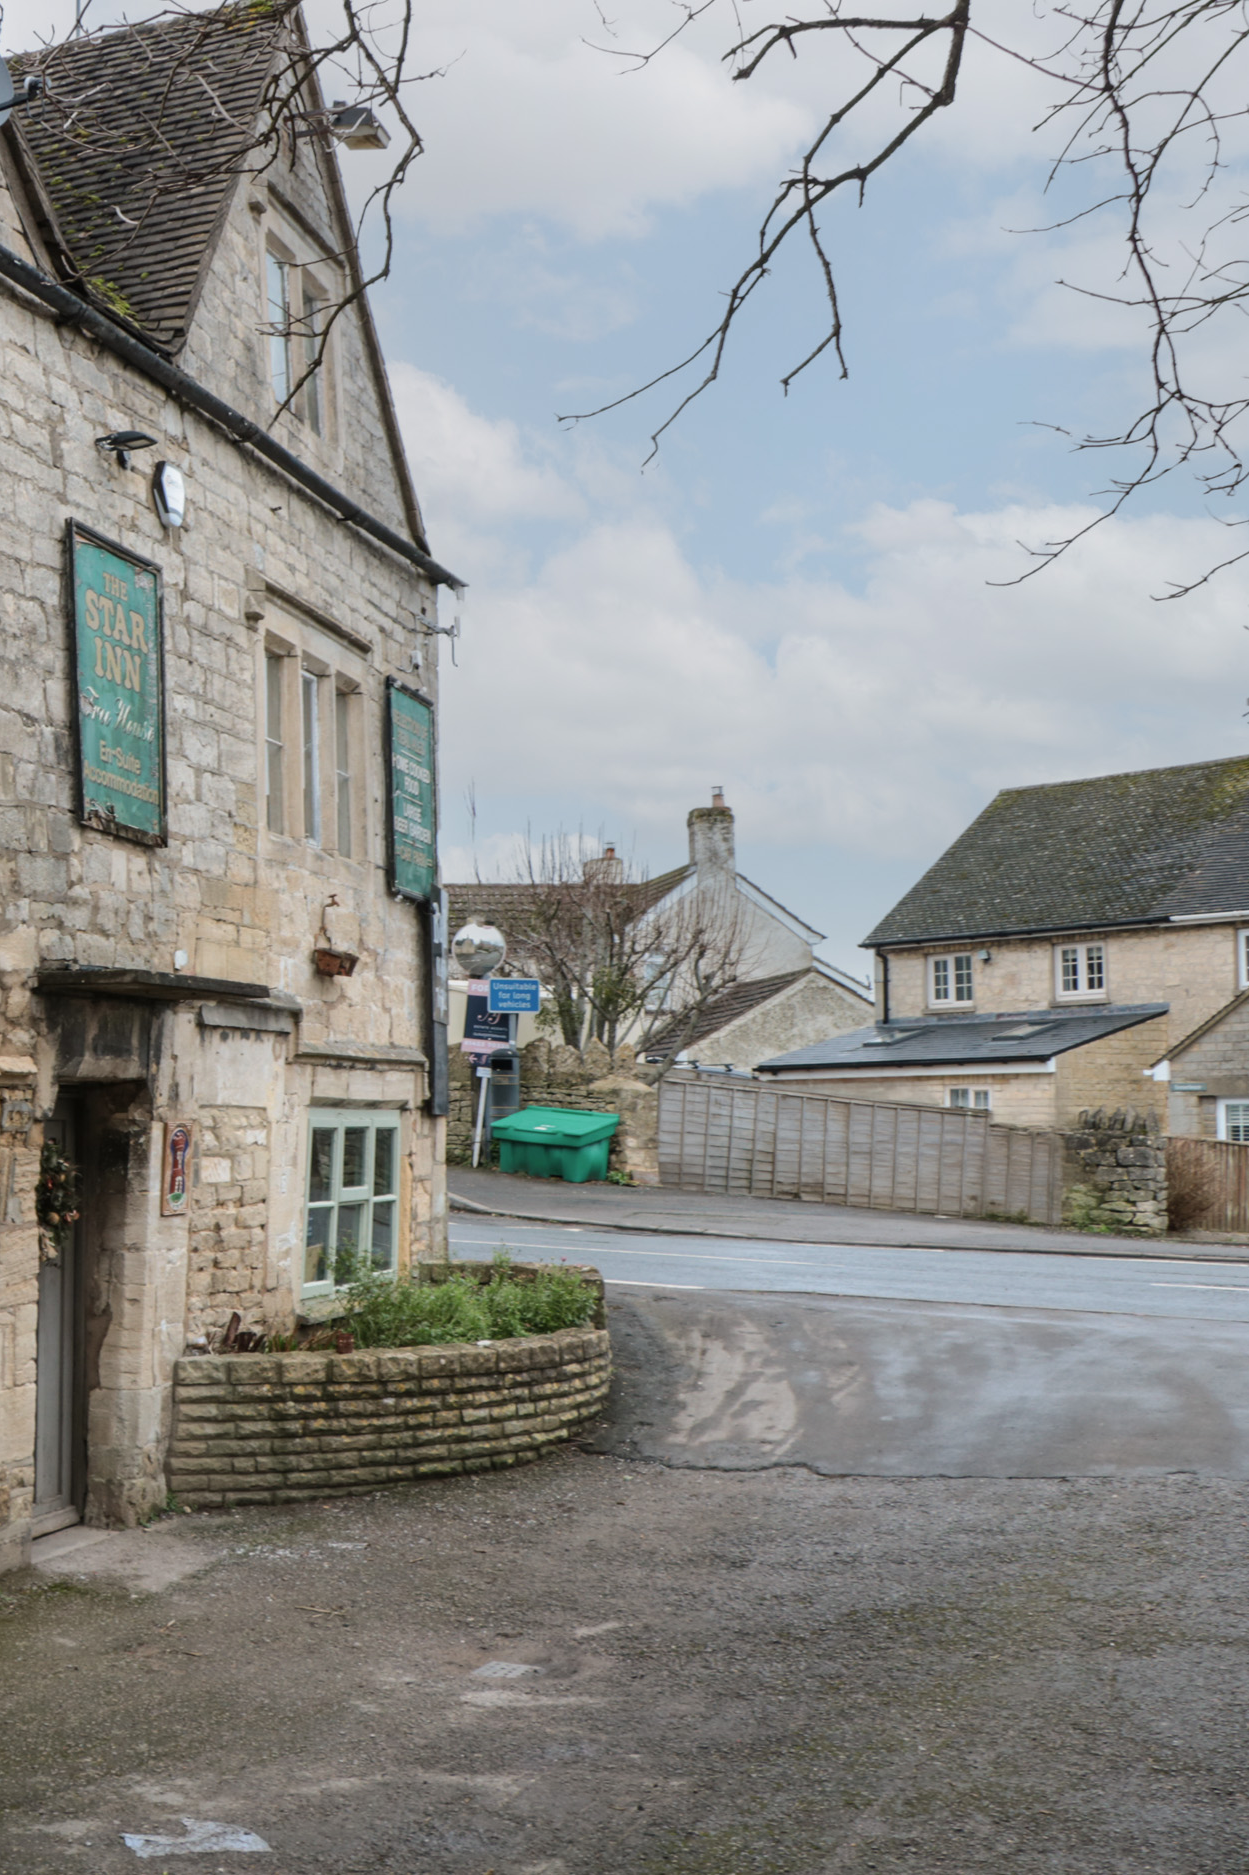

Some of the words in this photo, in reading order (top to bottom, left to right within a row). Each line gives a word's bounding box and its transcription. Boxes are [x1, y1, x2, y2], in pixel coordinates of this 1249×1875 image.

[102, 571, 128, 602] THE
[85, 588, 148, 654] STAR
[94, 635, 141, 693] INN
[114, 697, 155, 743] House
[99, 739, 141, 776] En-Suite
[392, 751, 409, 774] HOME
[409, 761, 431, 784] COOKED
[83, 759, 159, 805] Accommodation
[404, 775, 419, 796] FOOD
[403, 801, 422, 824] LARGE
[394, 815, 408, 835] BEER
[409, 822, 432, 845] GARDEN
[492, 982, 537, 991] Unsuitable
[498, 991, 511, 999] for
[512, 991, 531, 1001] long
[498, 1001, 531, 1009] vehicles
